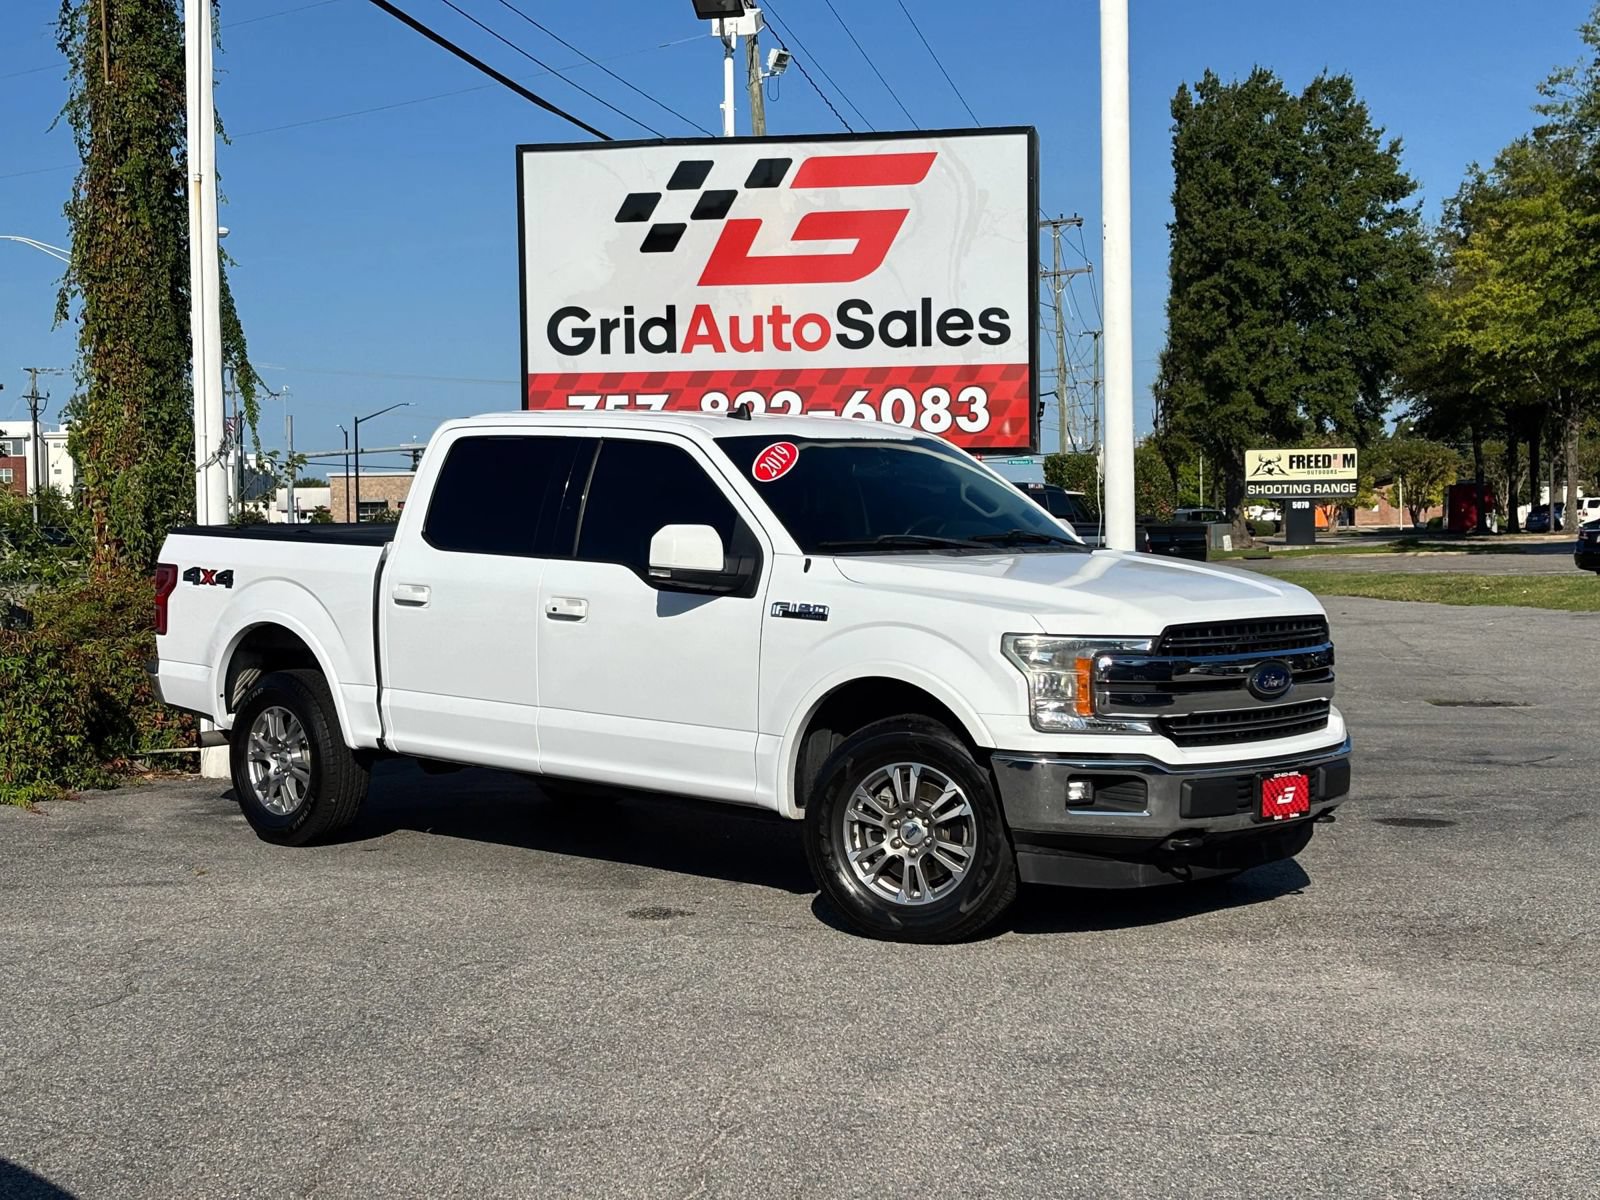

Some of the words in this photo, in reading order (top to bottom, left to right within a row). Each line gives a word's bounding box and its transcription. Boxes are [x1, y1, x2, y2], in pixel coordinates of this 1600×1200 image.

[760, 445, 790, 477] 2019
[1288, 453, 1356, 470] FREEDM
[1247, 483, 1311, 495] SHOOTING
[1313, 483, 1357, 493] RANGE
